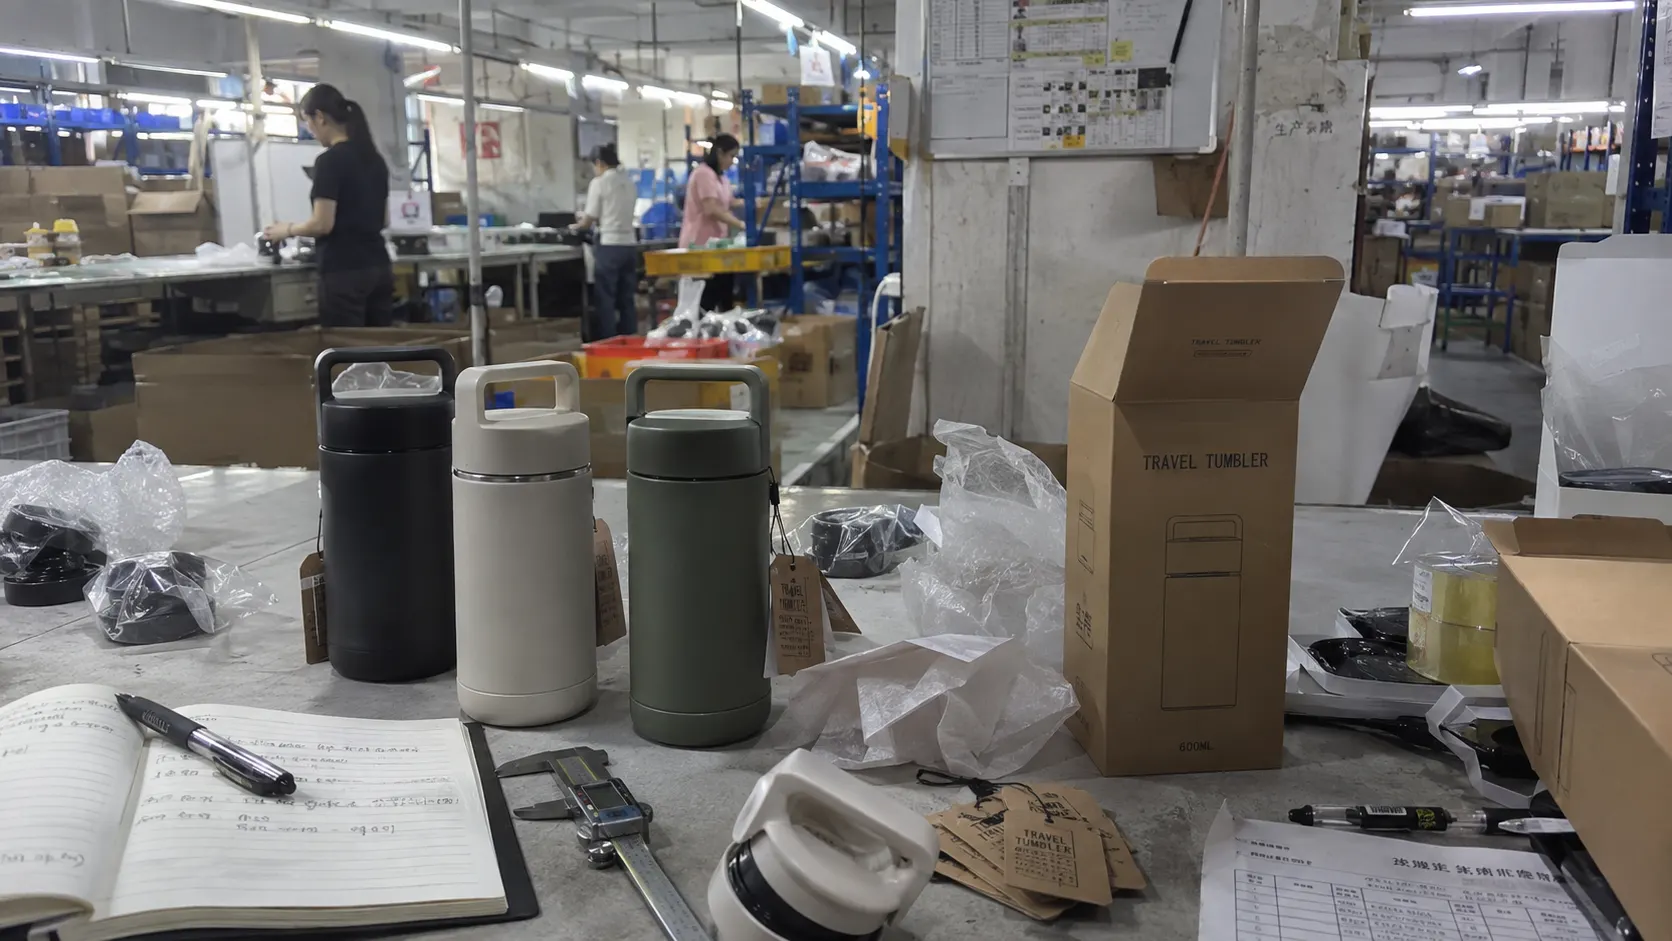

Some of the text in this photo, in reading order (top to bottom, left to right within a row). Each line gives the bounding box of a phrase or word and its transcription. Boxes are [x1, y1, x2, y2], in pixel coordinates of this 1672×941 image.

[1143, 451, 1269, 471] TRAVEL TUMBLER
[1179, 741, 1214, 753] 600ML
[1023, 829, 1067, 845] TRAVEL
